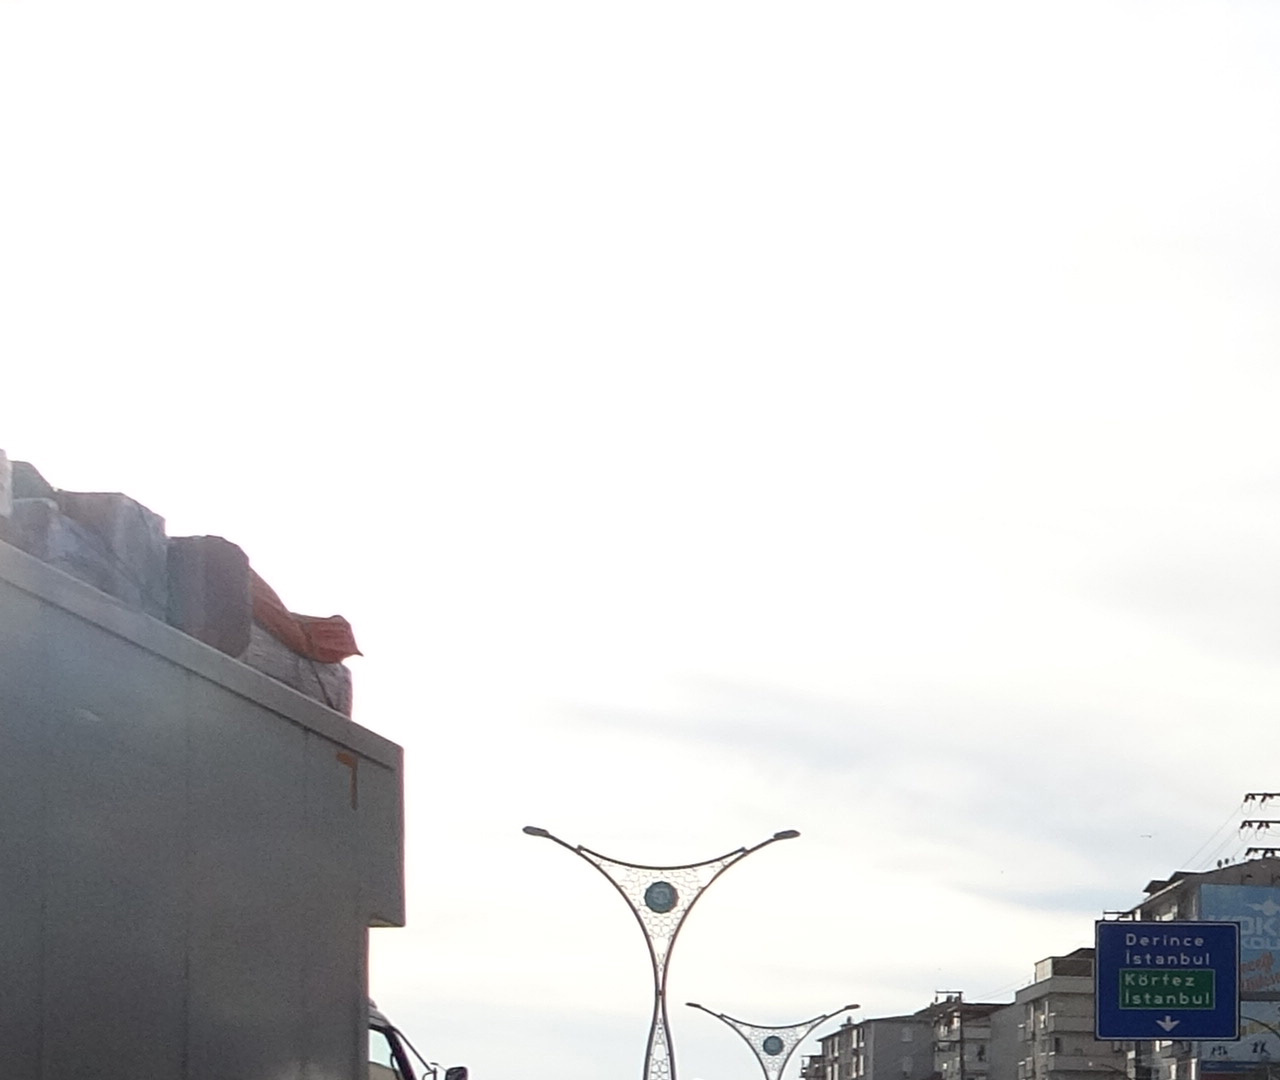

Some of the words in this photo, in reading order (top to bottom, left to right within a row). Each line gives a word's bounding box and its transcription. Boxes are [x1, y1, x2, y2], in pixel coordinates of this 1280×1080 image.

[1125, 933, 1205, 946] Derince
[1126, 949, 1210, 965] İstanbul
[1124, 973, 1196, 987] Körfez
[1125, 989, 1209, 1005] İstanbul
